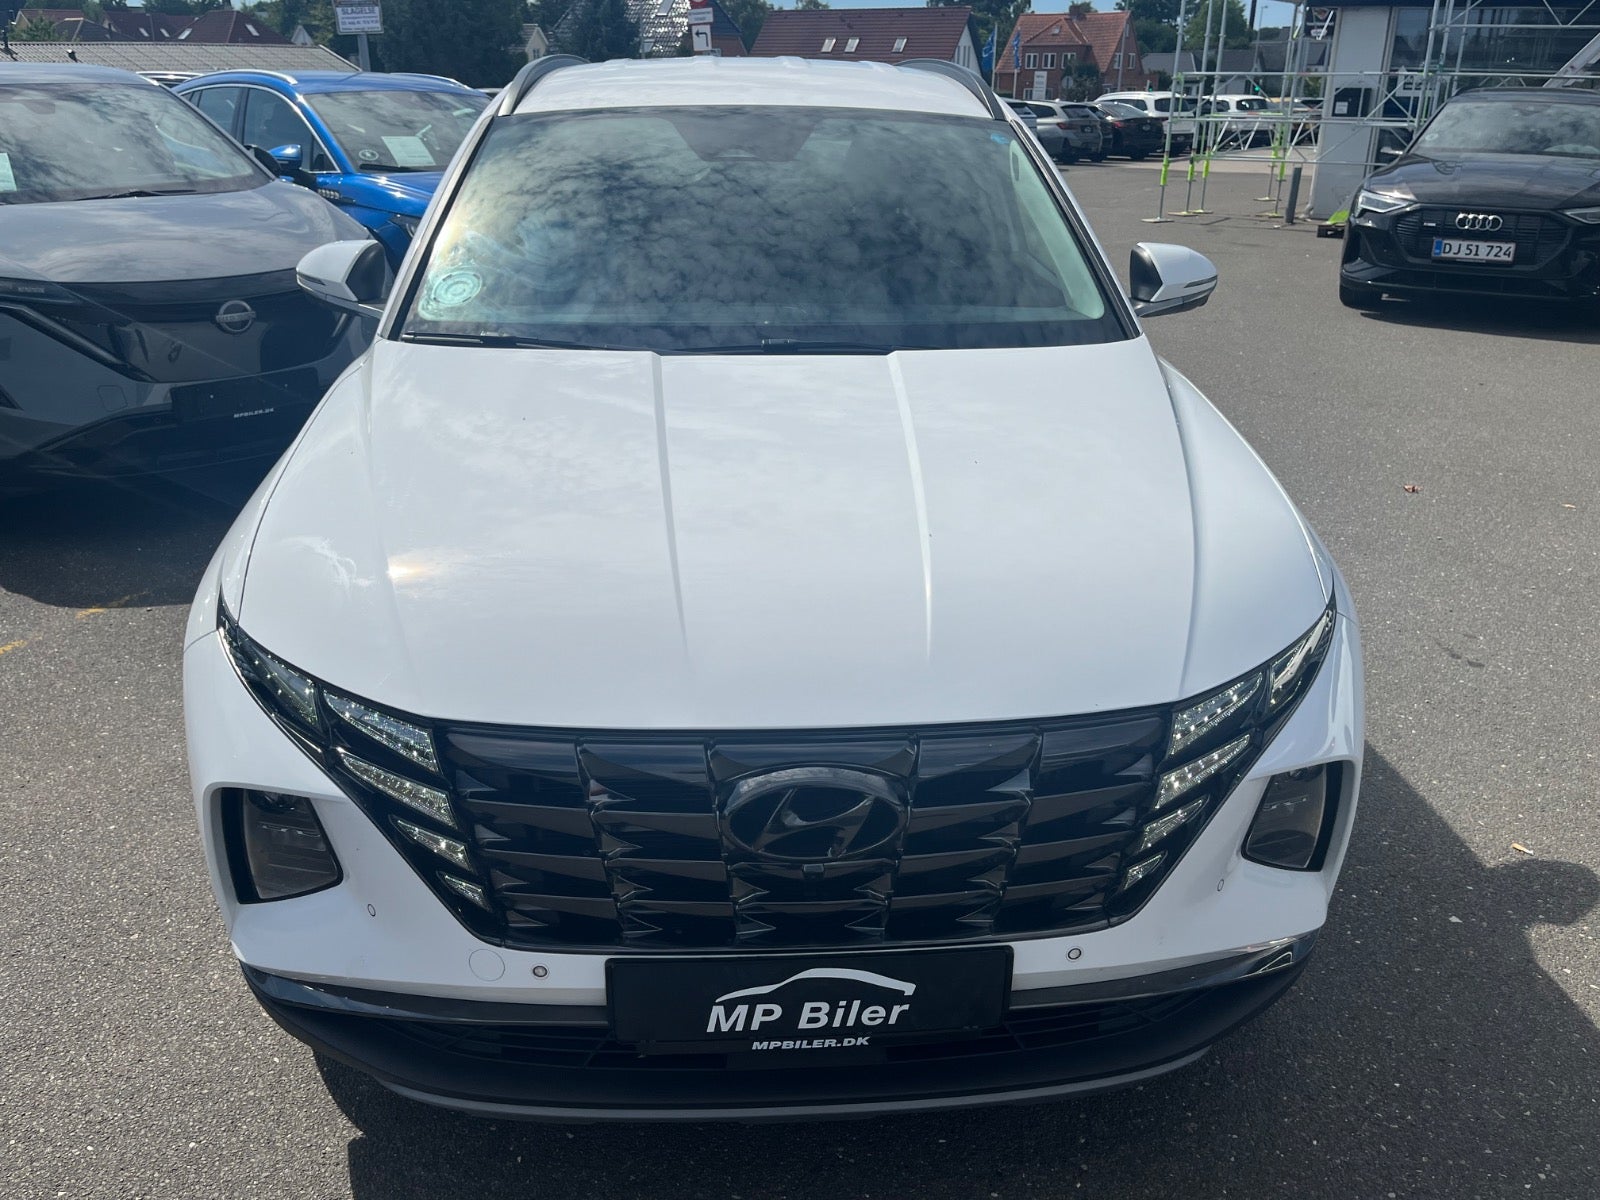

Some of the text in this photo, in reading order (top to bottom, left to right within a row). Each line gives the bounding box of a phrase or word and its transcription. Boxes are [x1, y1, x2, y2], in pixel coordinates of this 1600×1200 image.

[341, 7, 377, 15] SLAGELSE
[1443, 243, 1512, 258] DJ 51 724
[706, 1000, 910, 1033] MP Biler
[752, 1036, 871, 1050] MPBILER.DK
